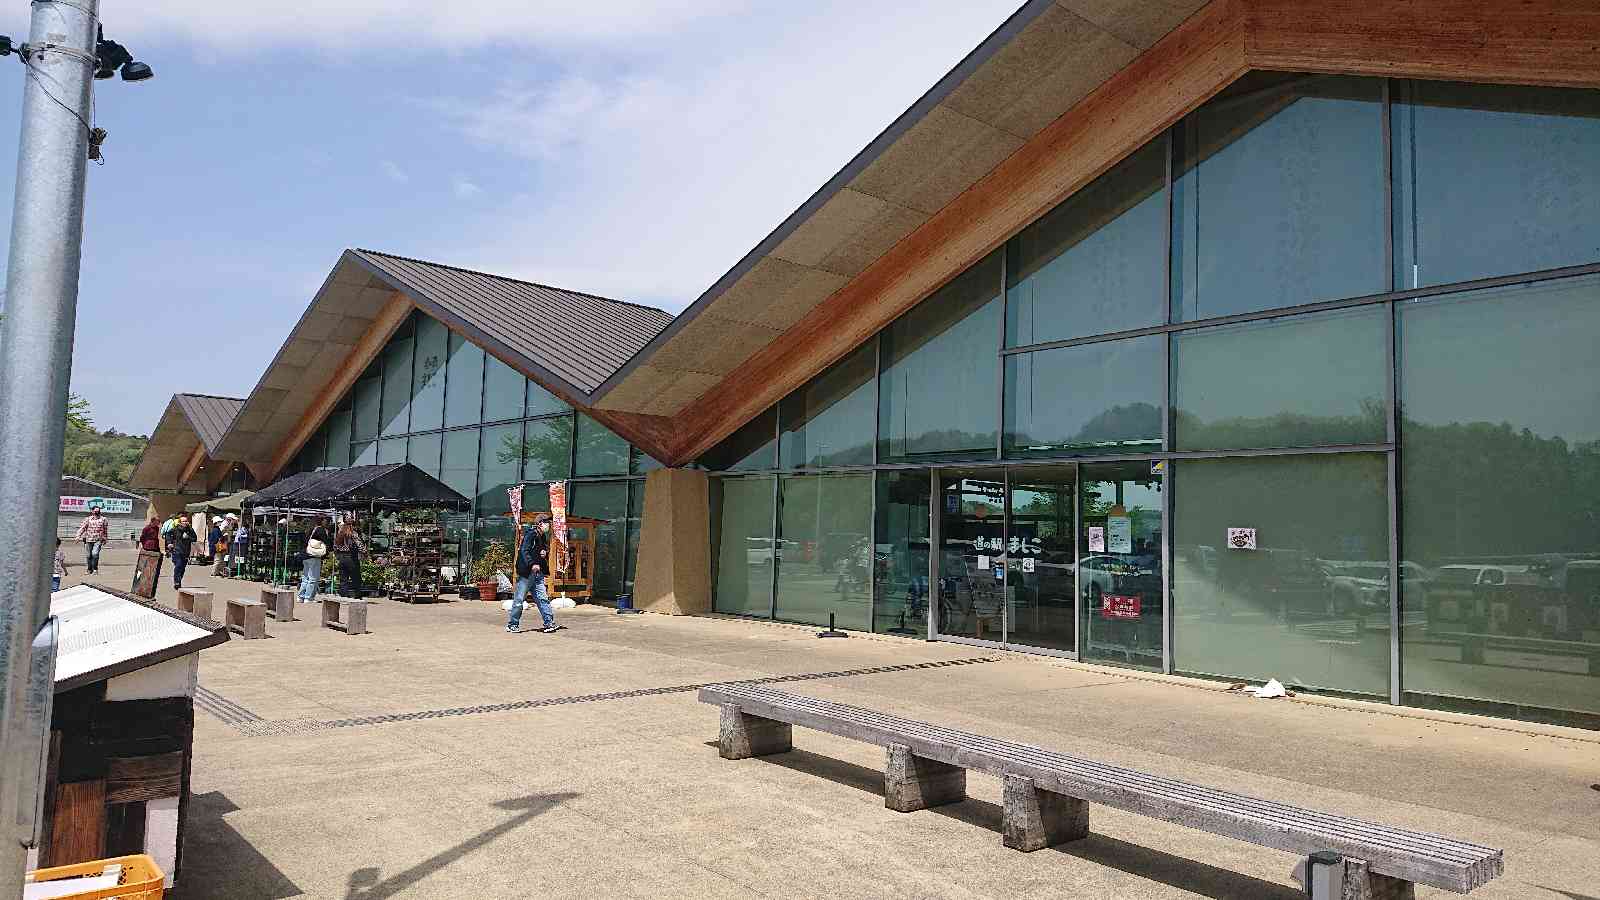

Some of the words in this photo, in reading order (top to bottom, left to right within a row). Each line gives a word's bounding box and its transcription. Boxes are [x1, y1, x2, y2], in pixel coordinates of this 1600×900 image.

[975, 535, 1002, 551] 道の駅
[1008, 535, 1042, 554] ましこ
